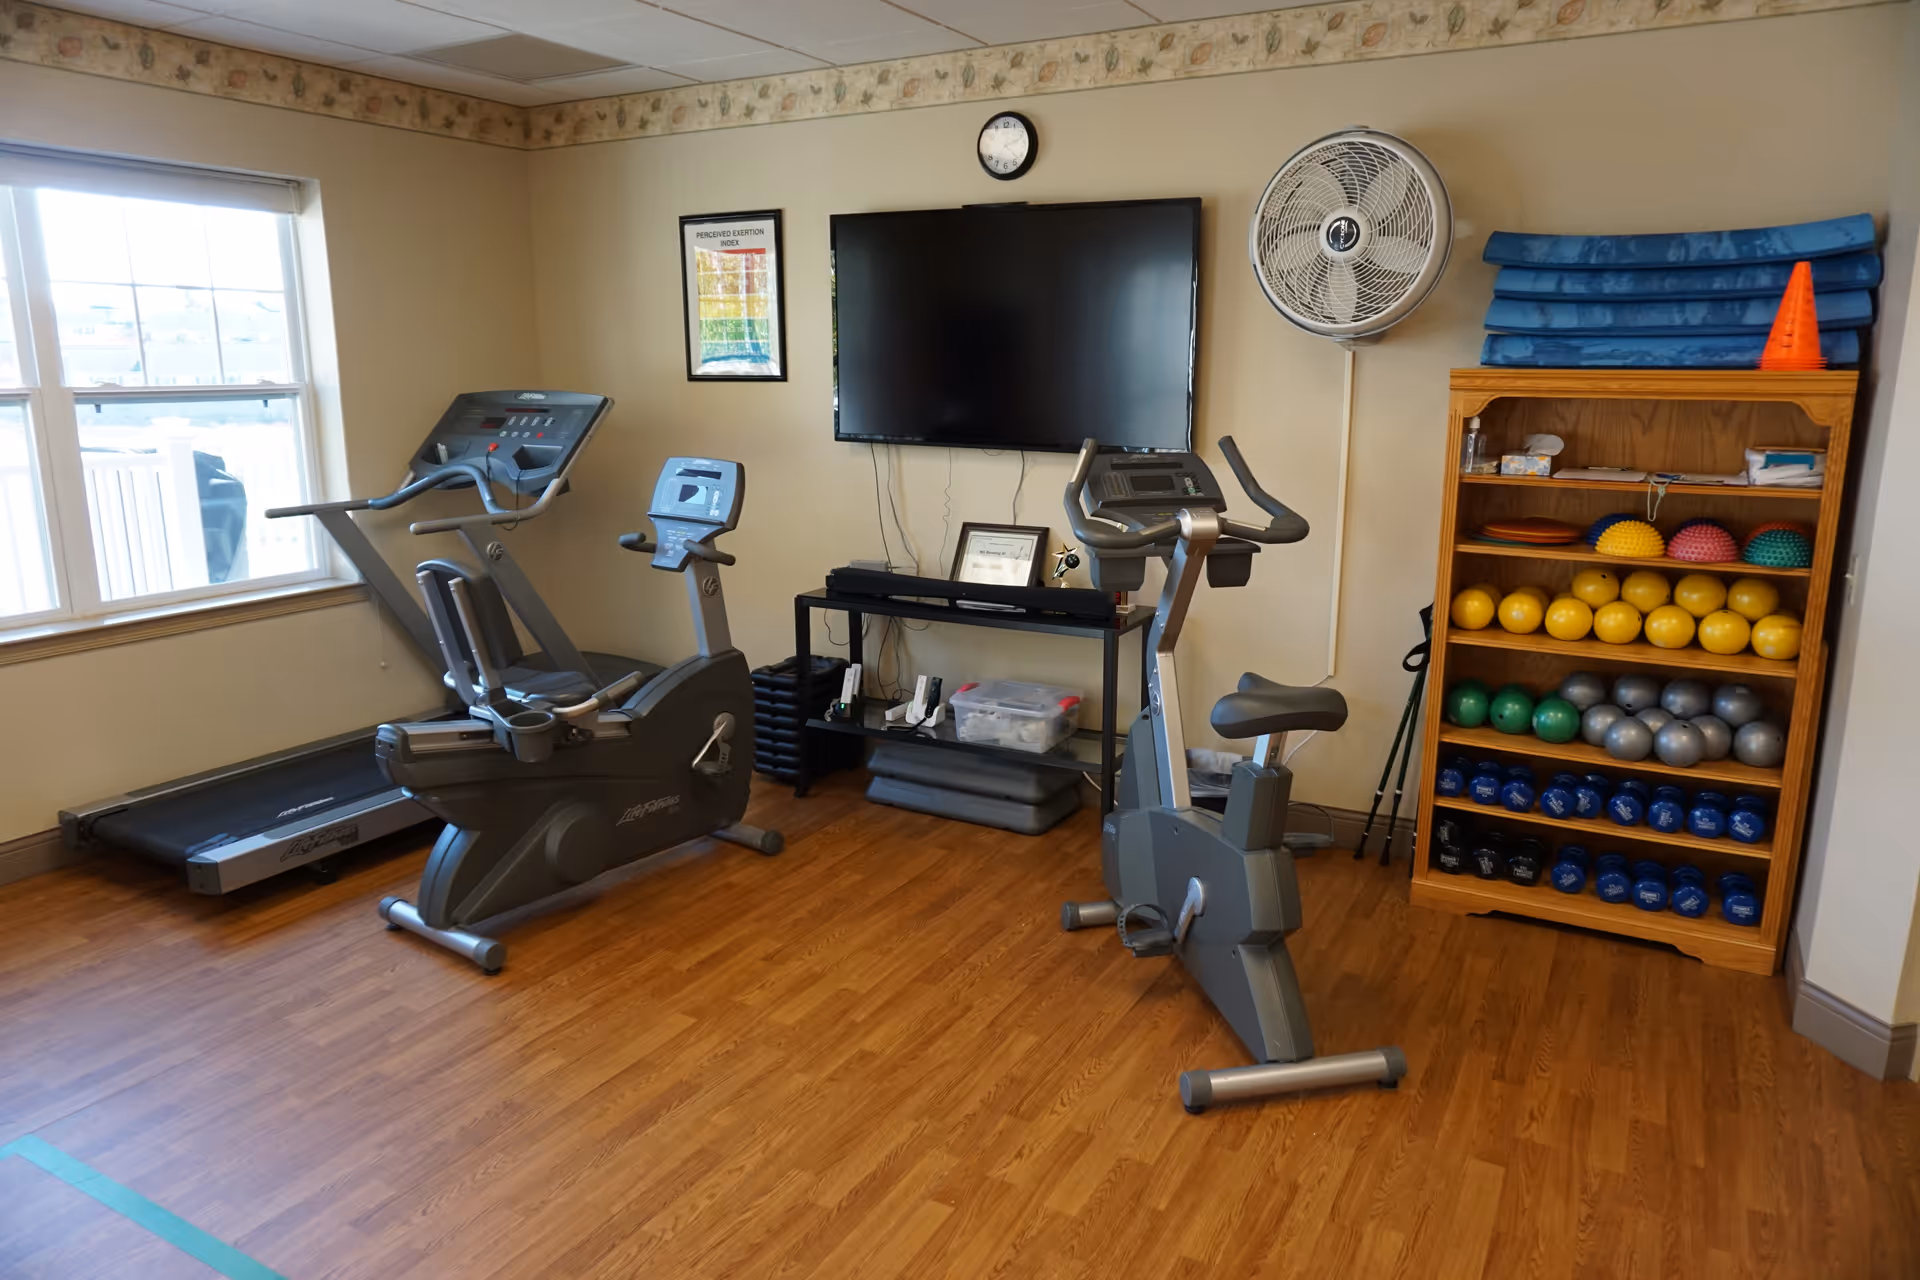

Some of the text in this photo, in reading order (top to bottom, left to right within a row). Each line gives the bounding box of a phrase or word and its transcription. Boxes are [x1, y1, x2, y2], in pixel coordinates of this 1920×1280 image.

[696, 228, 765, 239] PERCEIVED EXERTION
[720, 239, 740, 247] INDEX
